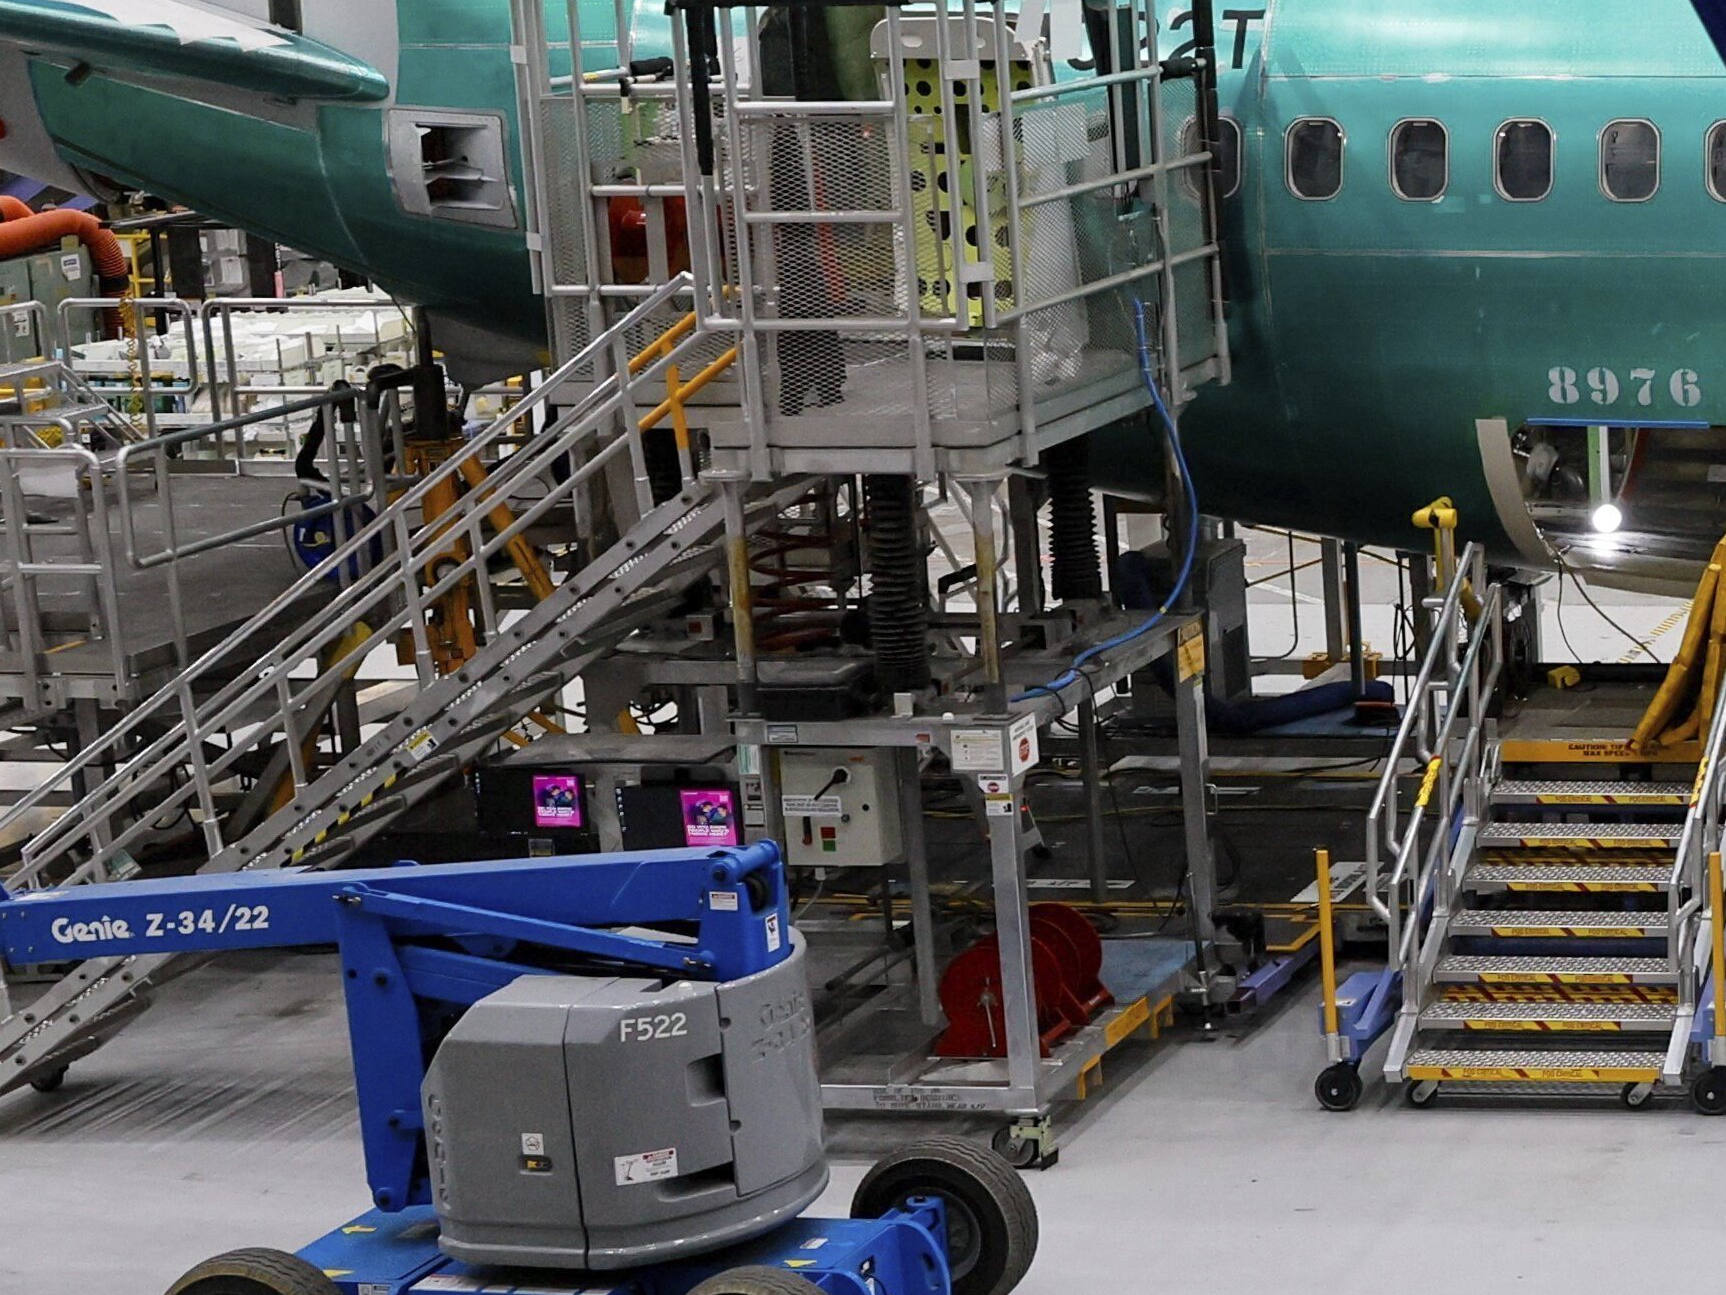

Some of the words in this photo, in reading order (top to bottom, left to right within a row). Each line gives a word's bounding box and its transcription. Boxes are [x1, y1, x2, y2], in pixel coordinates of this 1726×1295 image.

[1548, 366, 1701, 406] 8976
[52, 914, 130, 944] Genie
[146, 904, 269, 937] Z-34/22
[620, 1012, 688, 1043] F522
